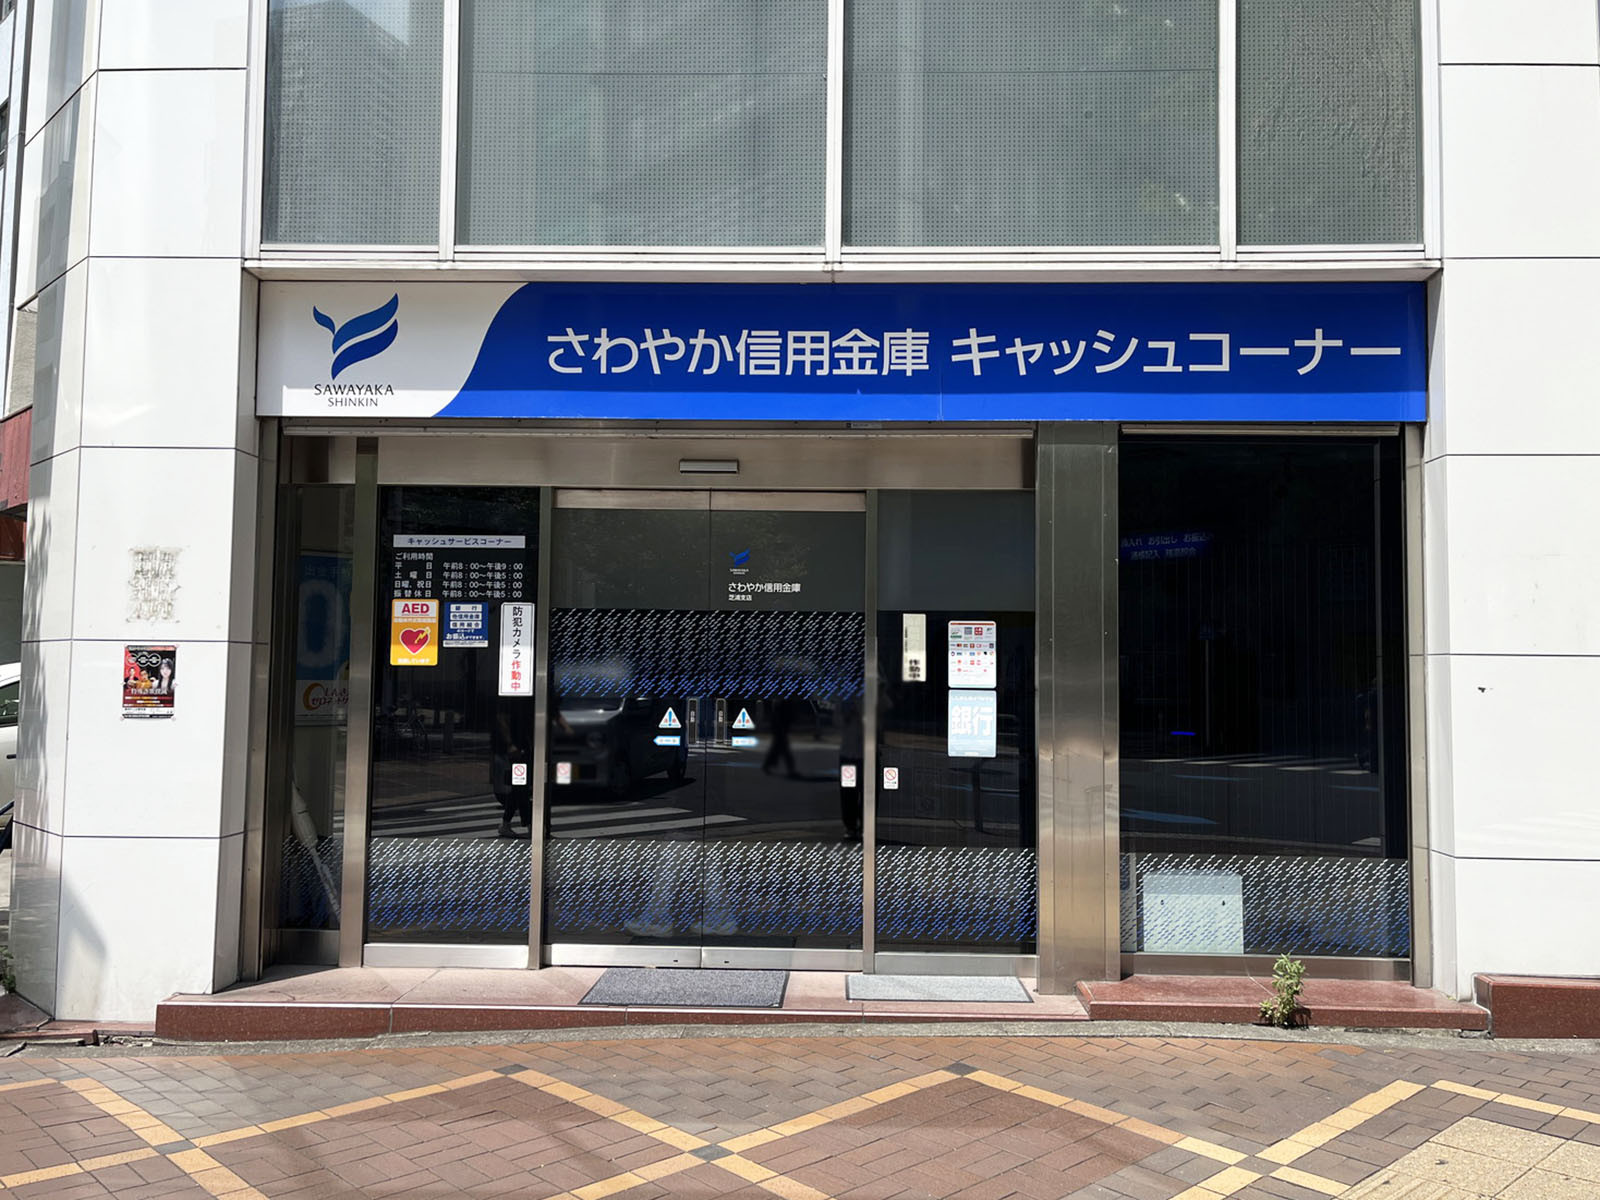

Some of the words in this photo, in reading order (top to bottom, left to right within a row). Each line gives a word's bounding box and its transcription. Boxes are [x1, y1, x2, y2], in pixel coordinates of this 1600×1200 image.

[547, 327, 930, 376] さわやか信用金庫
[951, 328, 1402, 376] キャッシュコーナー
[313, 384, 394, 396] SAWAYAKA
[328, 397, 378, 407] SHINKIN
[408, 537, 512, 546] キャッシュサービスコーナー
[395, 552, 434, 560] ご利用時間
[728, 582, 801, 592] さわやか信用金庫
[402, 603, 430, 614] AED
[511, 606, 523, 691] 防犯カメラ作動中
